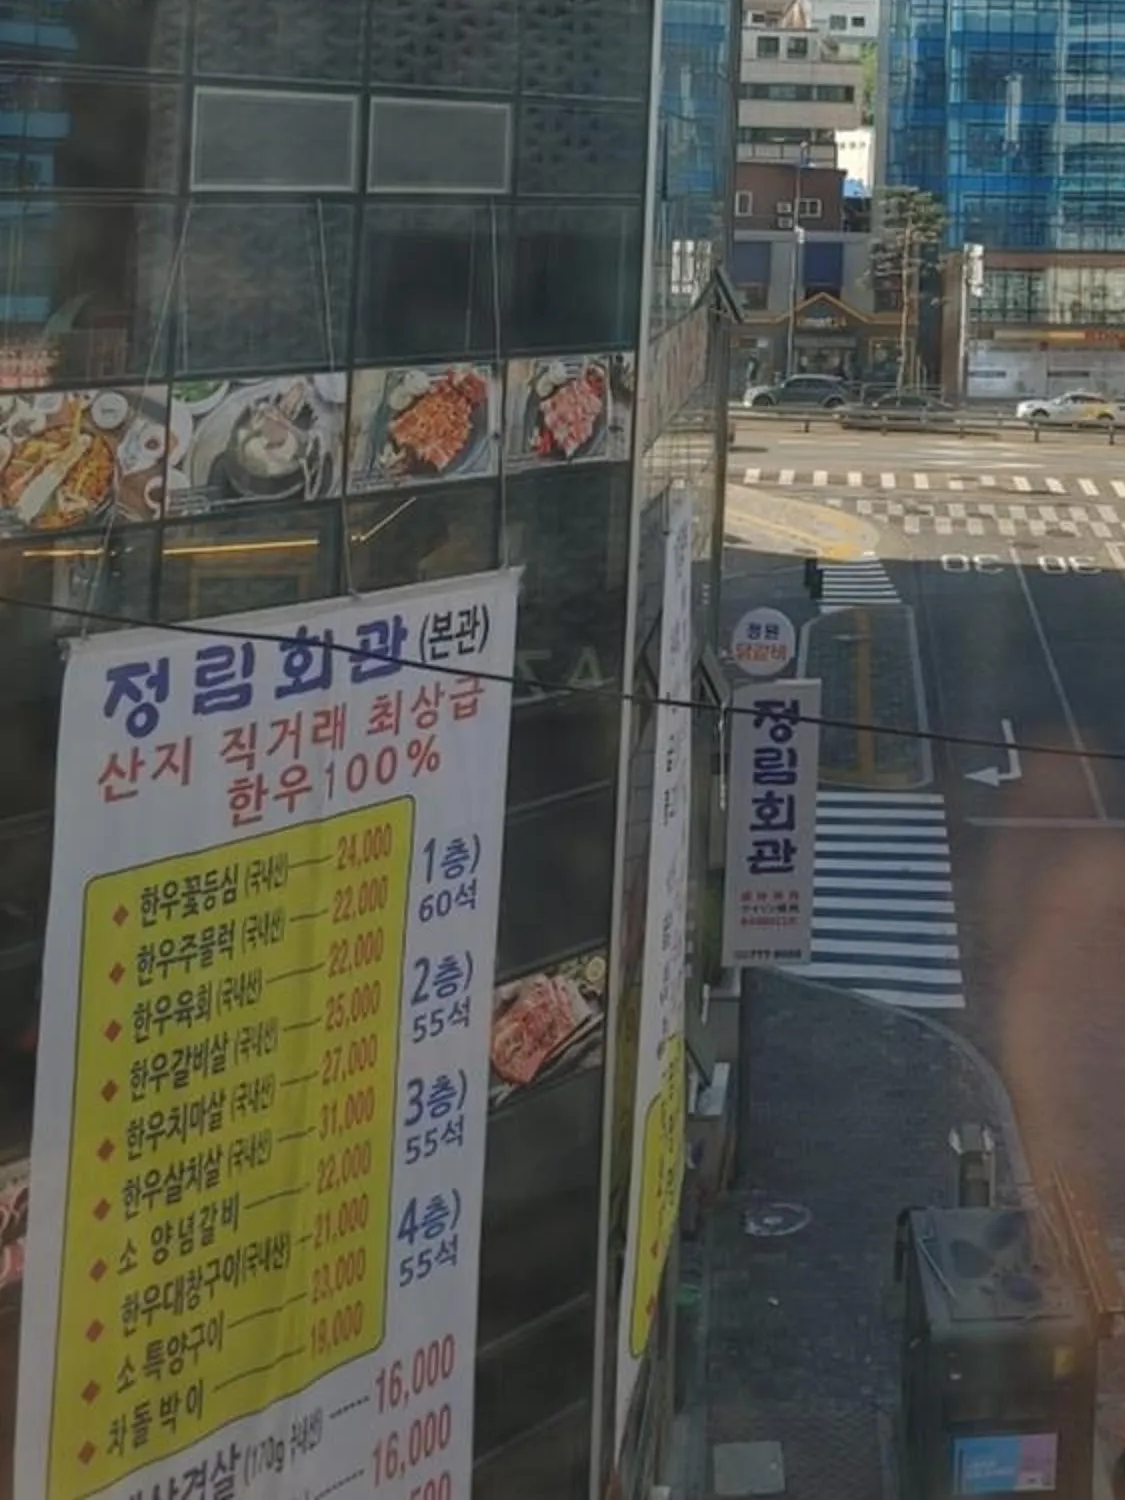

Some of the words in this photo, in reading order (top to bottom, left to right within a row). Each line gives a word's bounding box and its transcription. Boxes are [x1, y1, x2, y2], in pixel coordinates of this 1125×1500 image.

[103, 615, 408, 738] 정림회관
[419, 603, 489, 665] (본관)
[98, 737, 193, 803] 산지
[219, 703, 347, 772] 직거래
[366, 675, 486, 737] 최상급
[747, 699, 799, 875] 정림회관
[140, 874, 239, 929] 한우꽃등심
[336, 823, 393, 873] 24,000
[423, 834, 482, 884] 1층)
[137, 921, 236, 987] 한우주물럭
[331, 875, 390, 925] 22,000
[417, 881, 478, 923] 60석
[132, 982, 213, 1044] 한우육회
[327, 928, 385, 978] 22,000
[412, 951, 475, 1006] 2층)
[129, 1034, 231, 1102] 한우갈비살
[324, 981, 382, 1031] 25,000
[412, 999, 472, 1043] 55석
[126, 1093, 227, 1162] 한우치마살
[321, 1035, 379, 1086] 27,000
[403, 1068, 469, 1129] 3층)
[403, 1117, 466, 1166] 55석
[118, 1242, 139, 1276] 소
[150, 1194, 241, 1264] 양념갈비
[315, 1140, 373, 1194] 22,000
[121, 1150, 224, 1222] 한우살치살
[396, 1187, 463, 1246] 4층)
[399, 1233, 460, 1288] 55석
[115, 1356, 138, 1394] 소
[144, 1311, 226, 1381] 특양구이
[374, 1334, 457, 1415] 16,000
[107, 1379, 206, 1459] 차돌박이
[370, 1404, 453, 1488] 16,000
